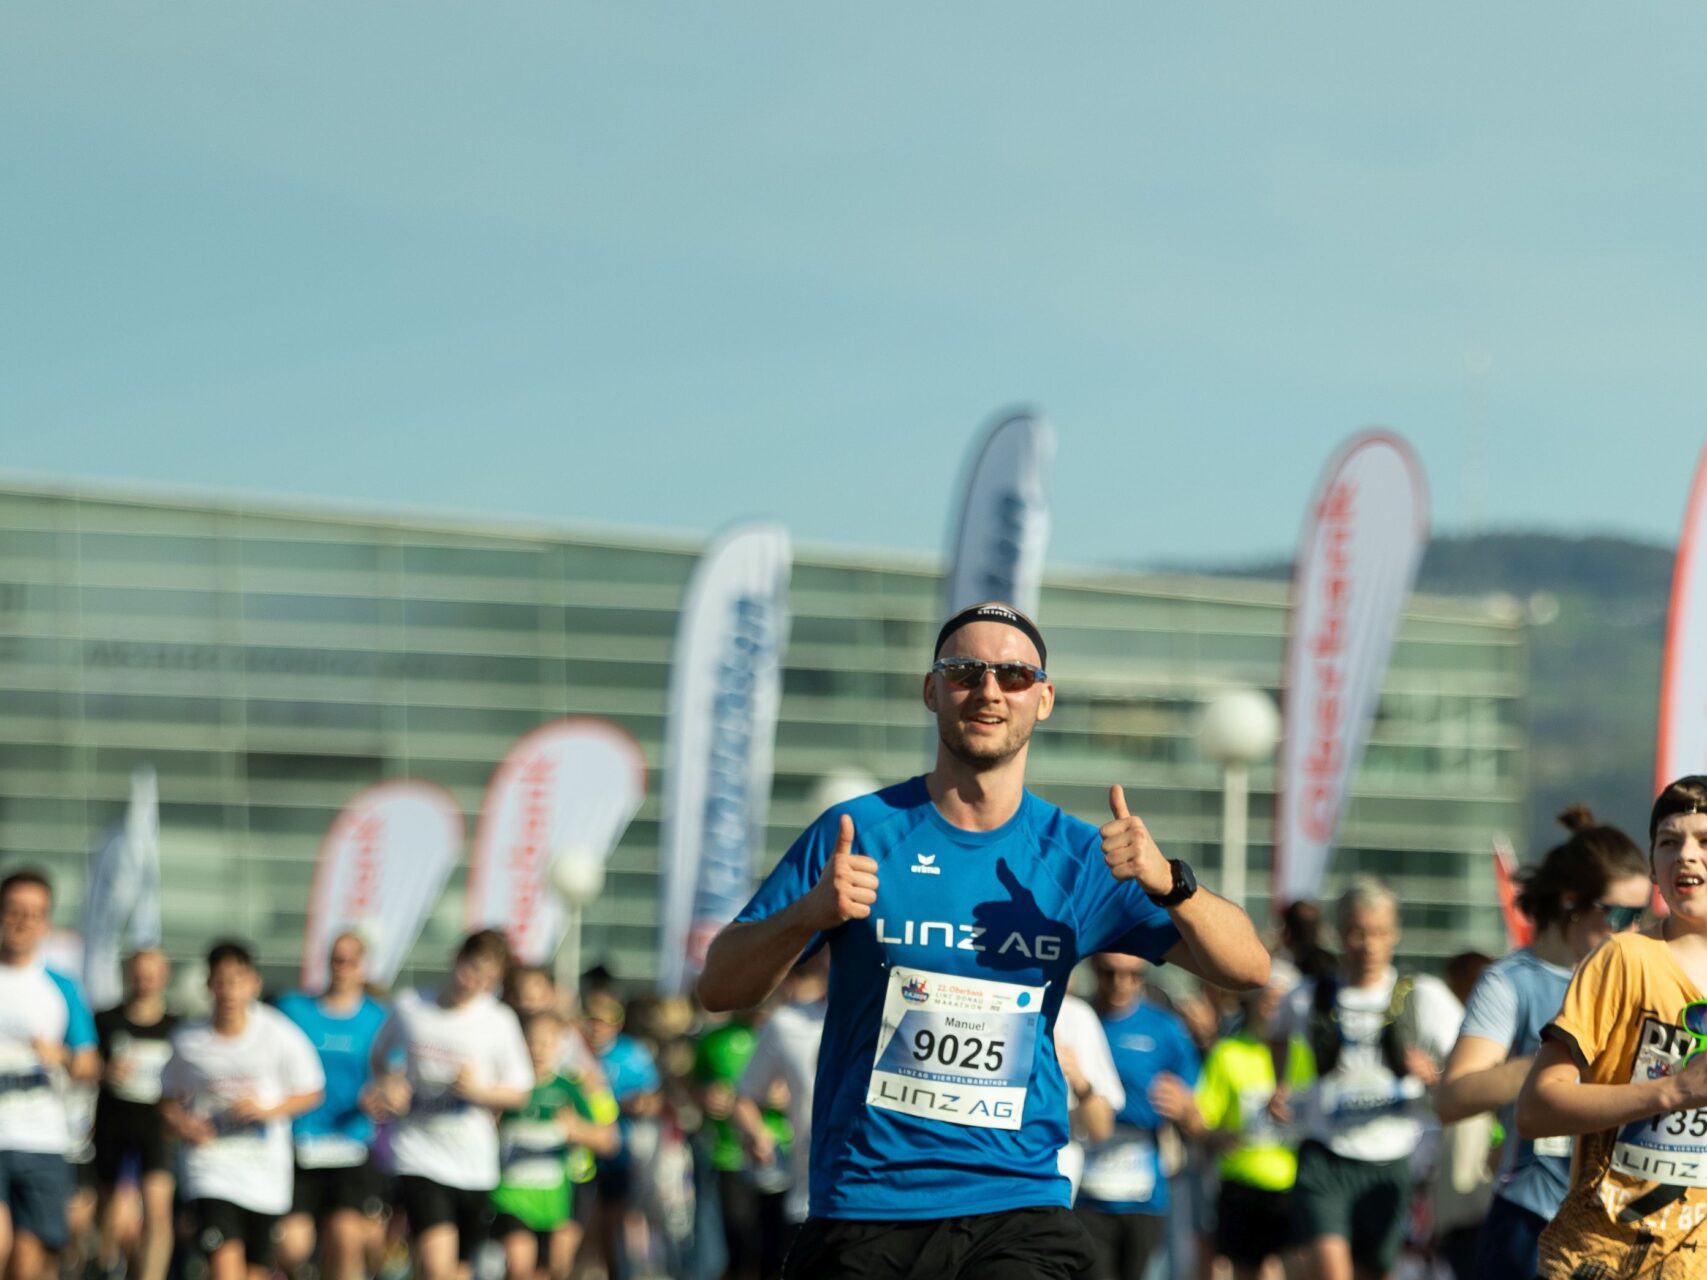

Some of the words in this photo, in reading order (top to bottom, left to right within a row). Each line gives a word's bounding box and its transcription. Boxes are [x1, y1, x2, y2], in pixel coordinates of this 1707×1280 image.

[911, 864, 941, 875] erima
[876, 918, 987, 952] LINZ
[998, 931, 1062, 961] AG
[945, 1016, 985, 1032] Manuel
[912, 1029, 1005, 1072] 9025
[880, 1080, 960, 1113] LINZ
[968, 1099, 1013, 1119] AG
[1622, 1151, 1699, 1178] LINZ
